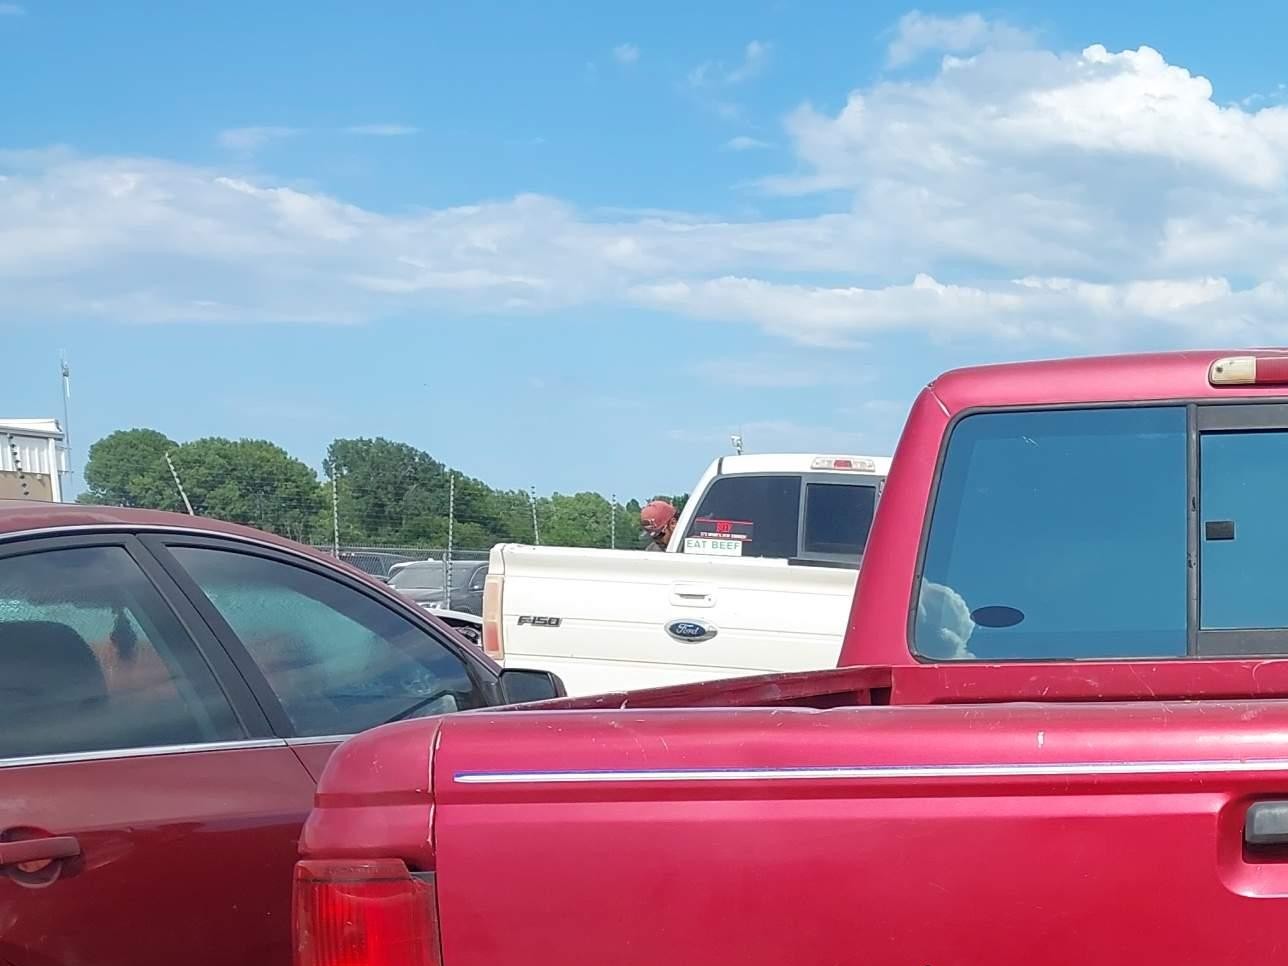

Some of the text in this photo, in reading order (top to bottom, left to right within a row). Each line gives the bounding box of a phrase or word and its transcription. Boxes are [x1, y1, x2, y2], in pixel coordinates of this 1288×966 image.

[686, 539, 740, 550] EAT BEEF
[517, 615, 562, 627] F-150
[675, 623, 700, 635] Ford
